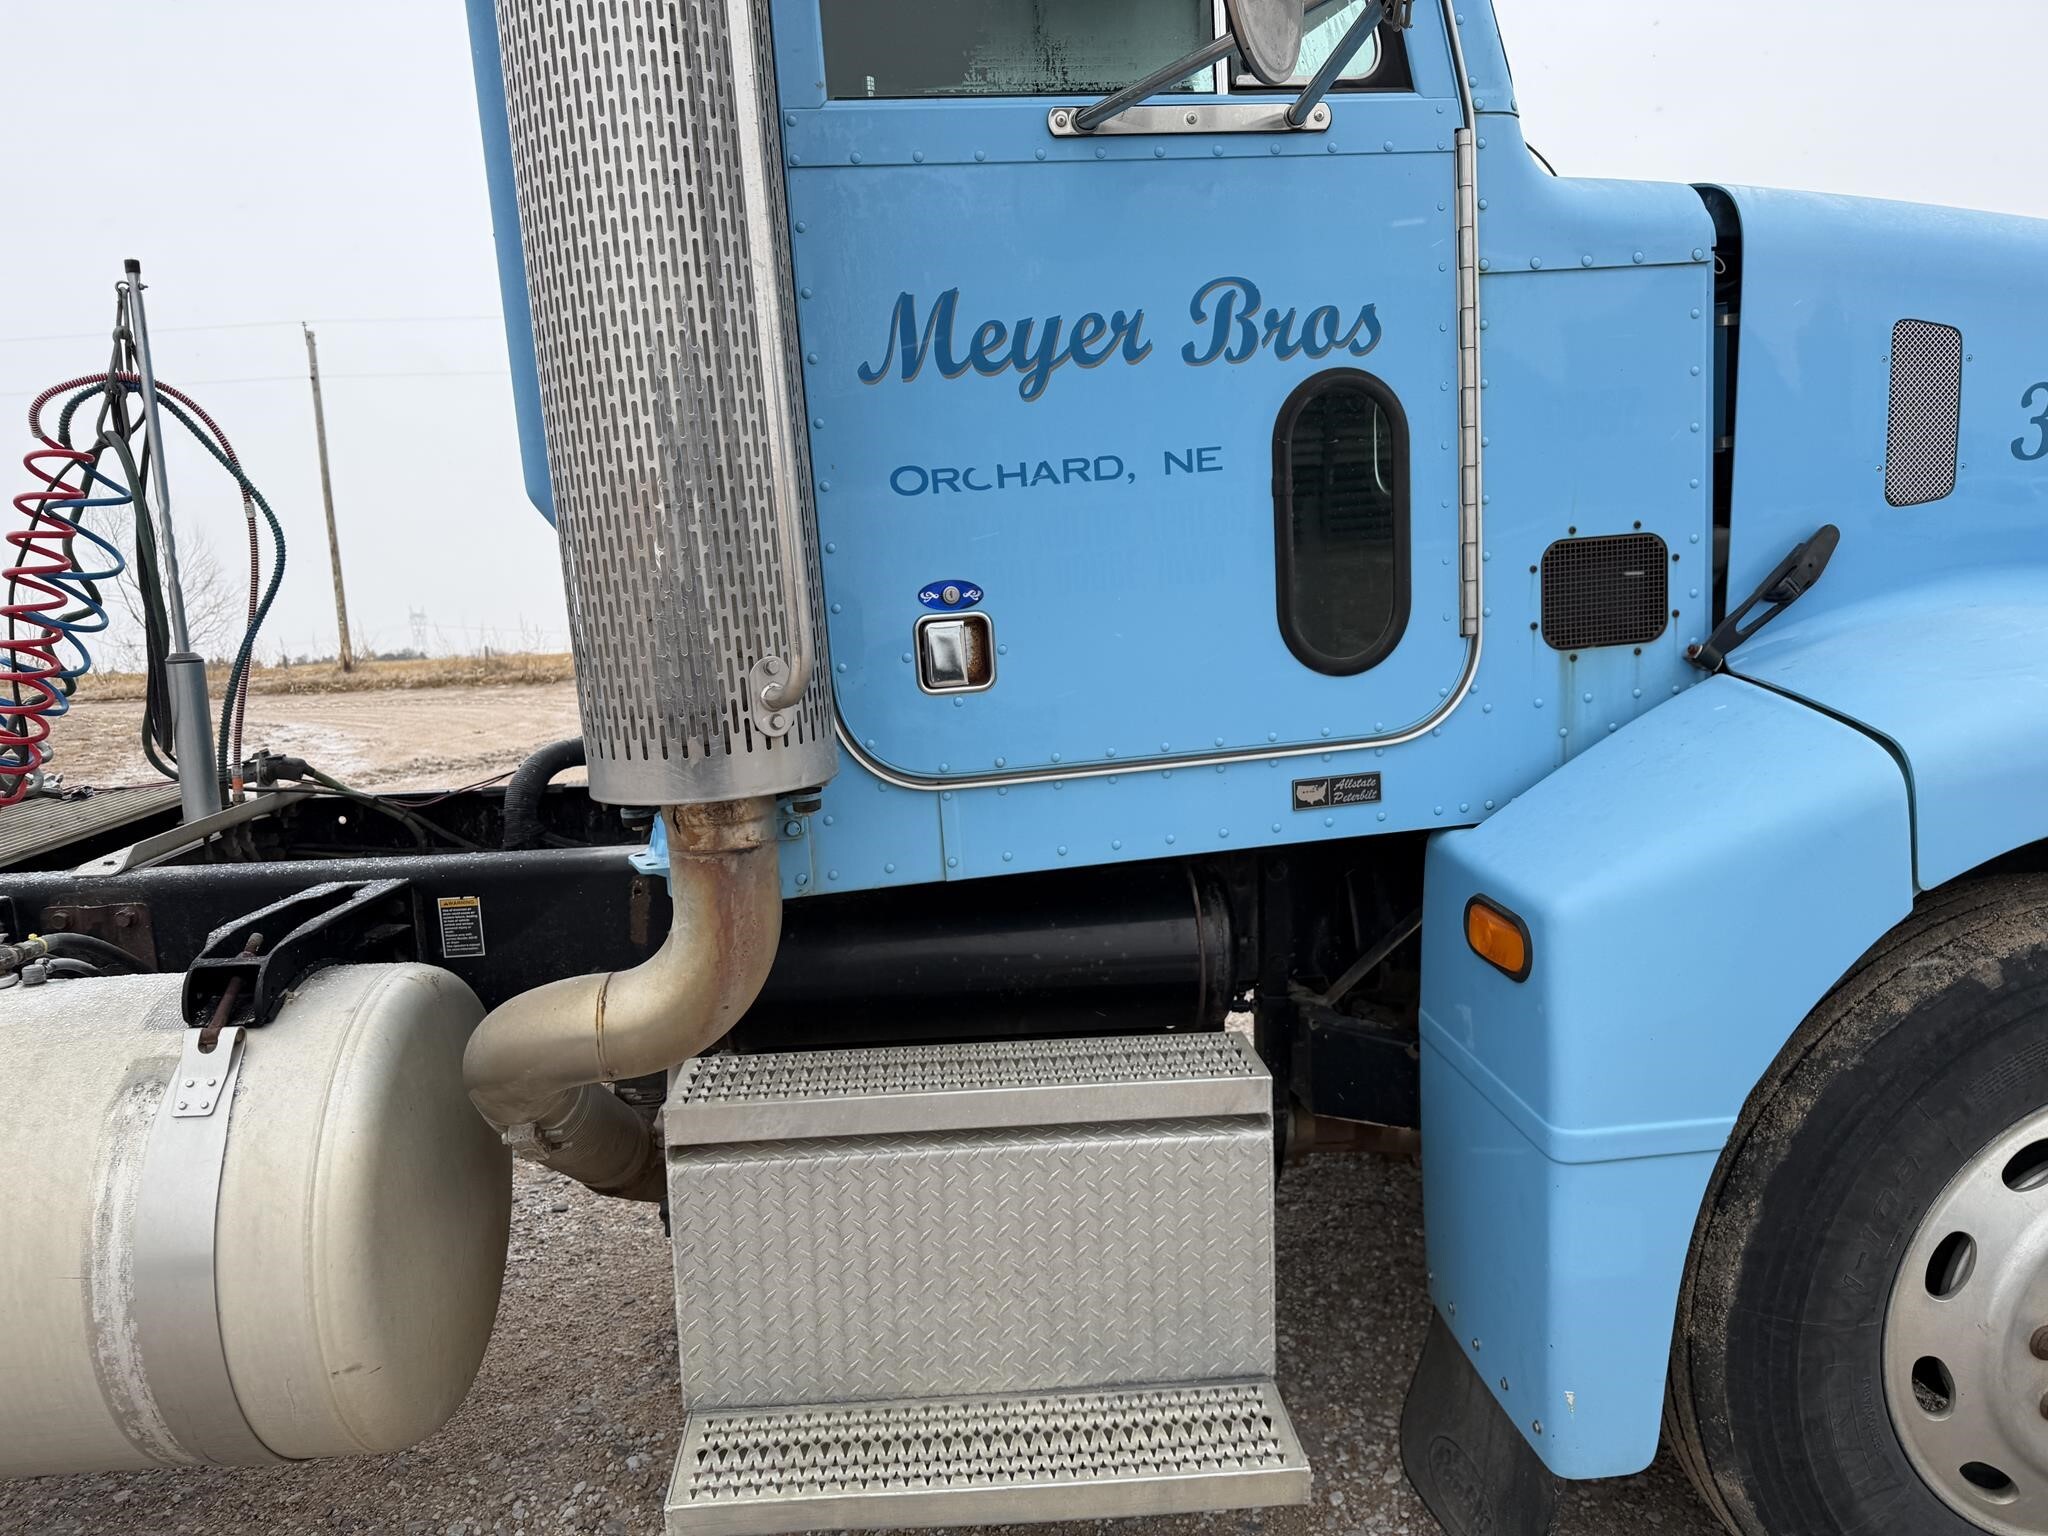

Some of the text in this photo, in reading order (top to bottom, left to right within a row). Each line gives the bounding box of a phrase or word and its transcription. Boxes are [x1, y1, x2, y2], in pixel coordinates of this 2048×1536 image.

[857, 276, 1382, 402] Meyer Bros
[2010, 381, 2048, 461] 3
[889, 446, 1224, 496] ORCHARD, NE
[1333, 777, 1377, 791] Allstate
[1333, 789, 1377, 803] Peterbilt
